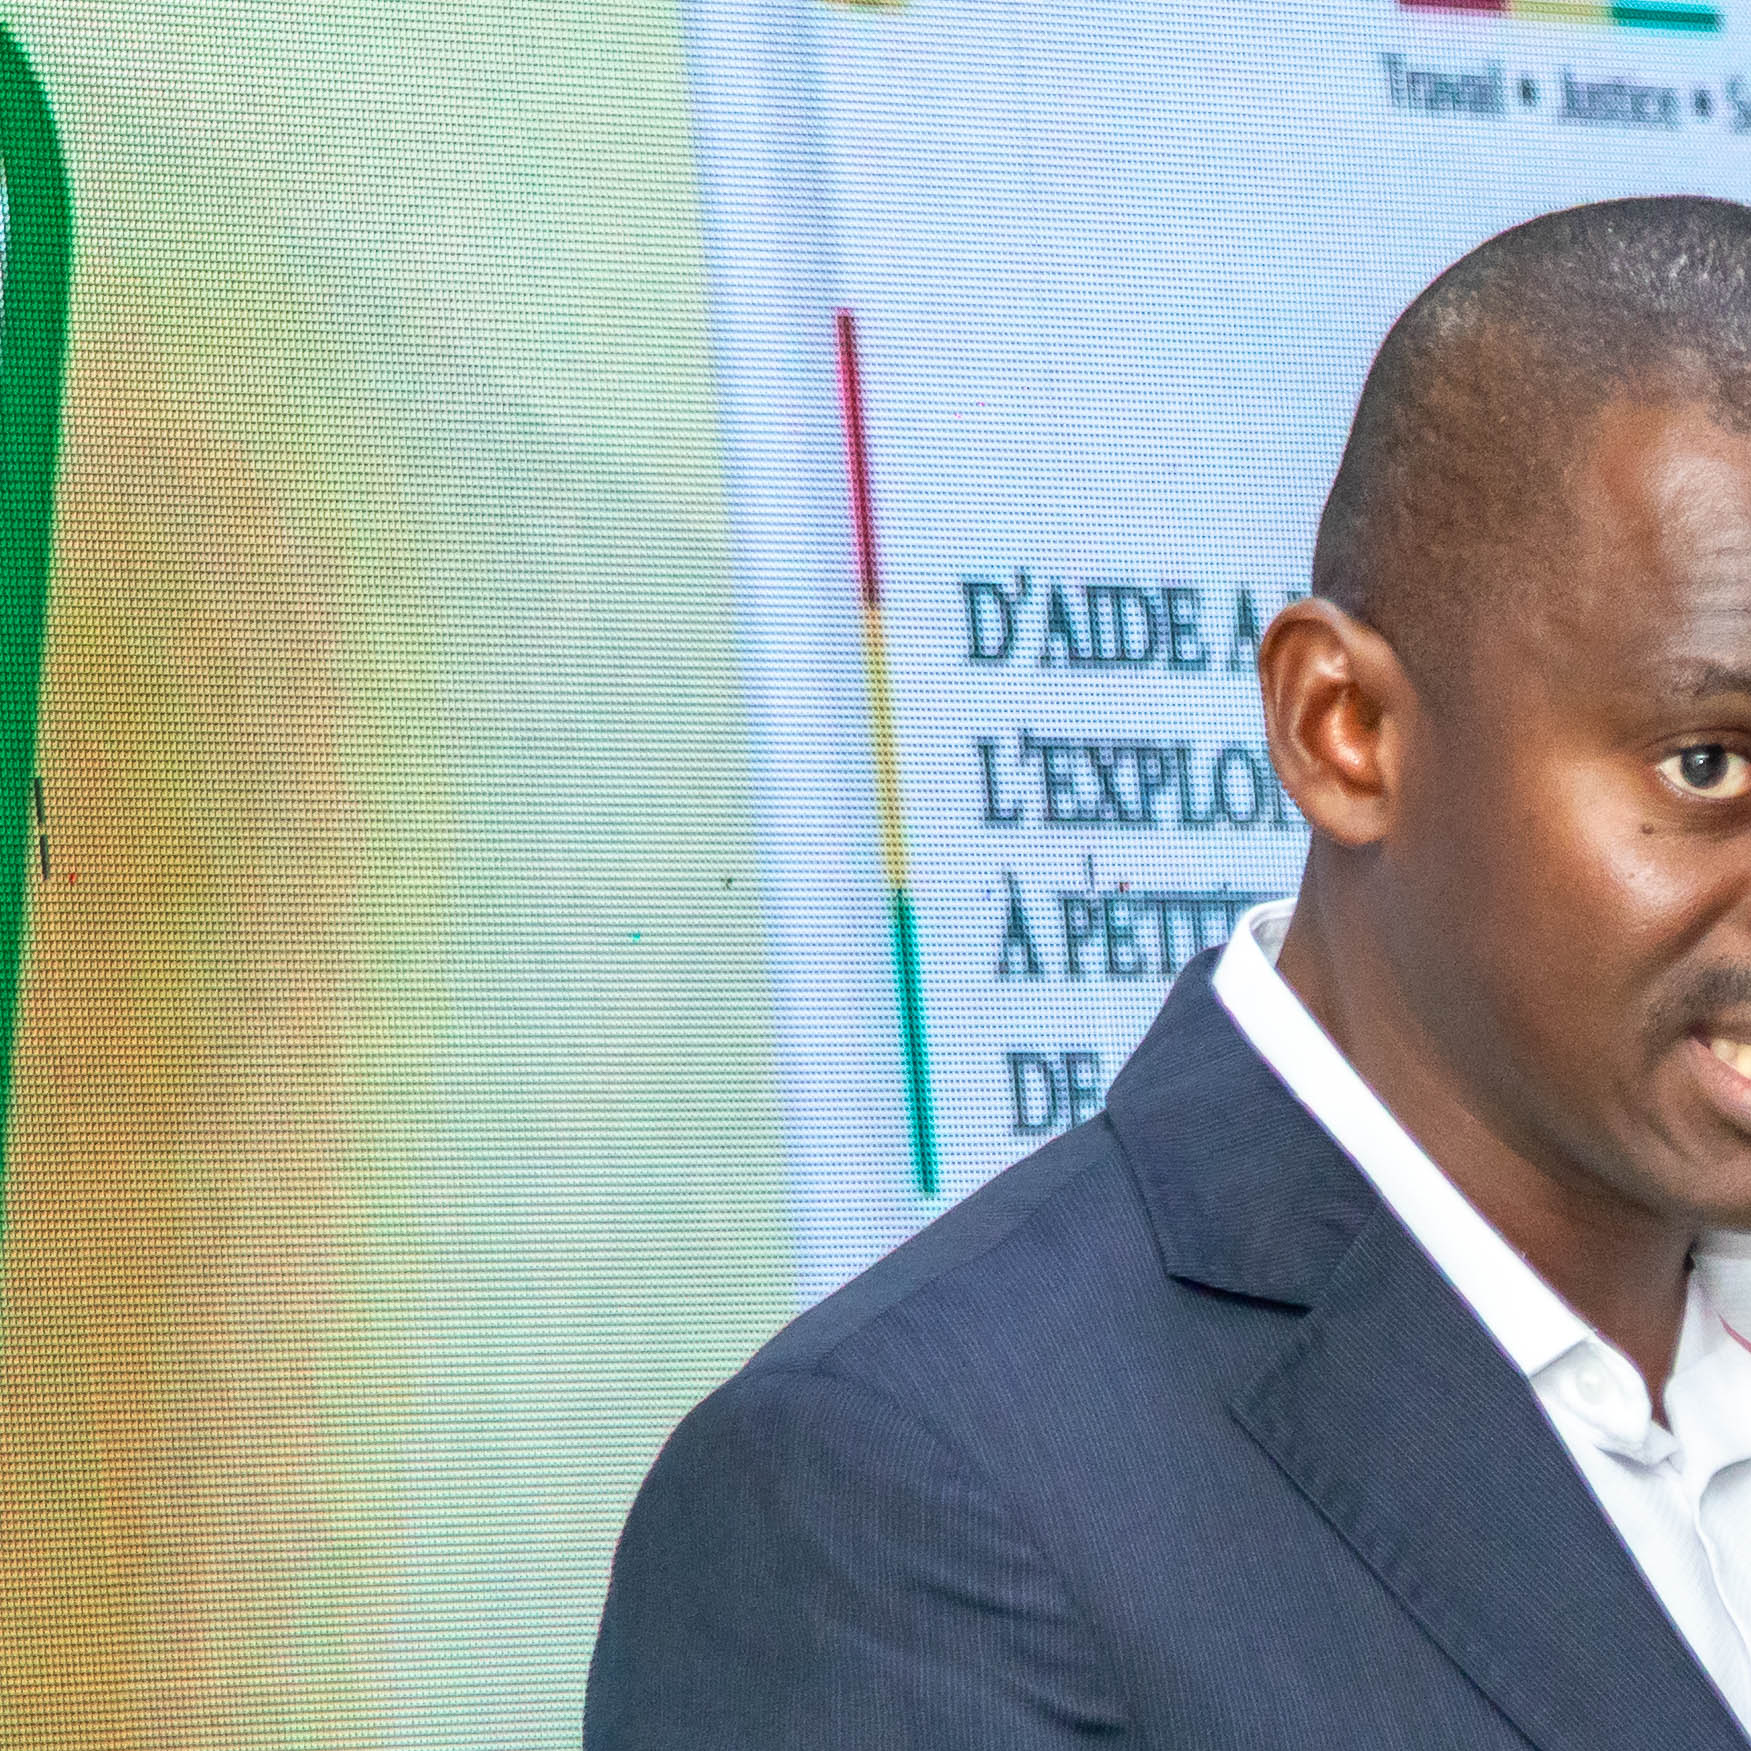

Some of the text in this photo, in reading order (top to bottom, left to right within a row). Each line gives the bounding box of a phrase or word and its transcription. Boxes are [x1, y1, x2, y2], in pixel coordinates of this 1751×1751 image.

[1380, 52, 1506, 115] Travail
[1556, 66, 1682, 130] Justice
[960, 567, 1208, 671] D'AIDE
